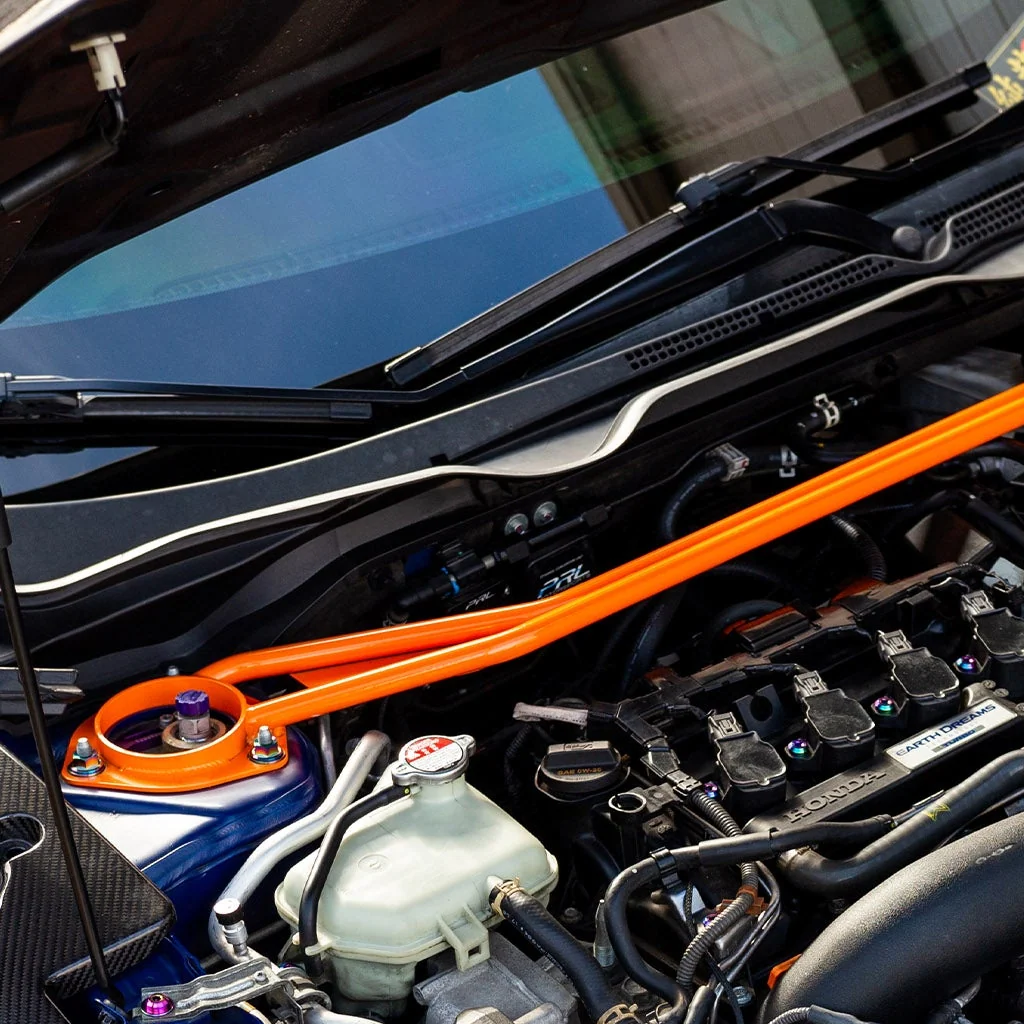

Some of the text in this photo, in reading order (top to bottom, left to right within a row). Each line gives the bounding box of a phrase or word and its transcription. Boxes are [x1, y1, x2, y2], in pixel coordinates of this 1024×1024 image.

[895, 731, 941, 757] EARTH
[940, 703, 997, 735] DREAMS
[783, 771, 887, 823] HONDA
